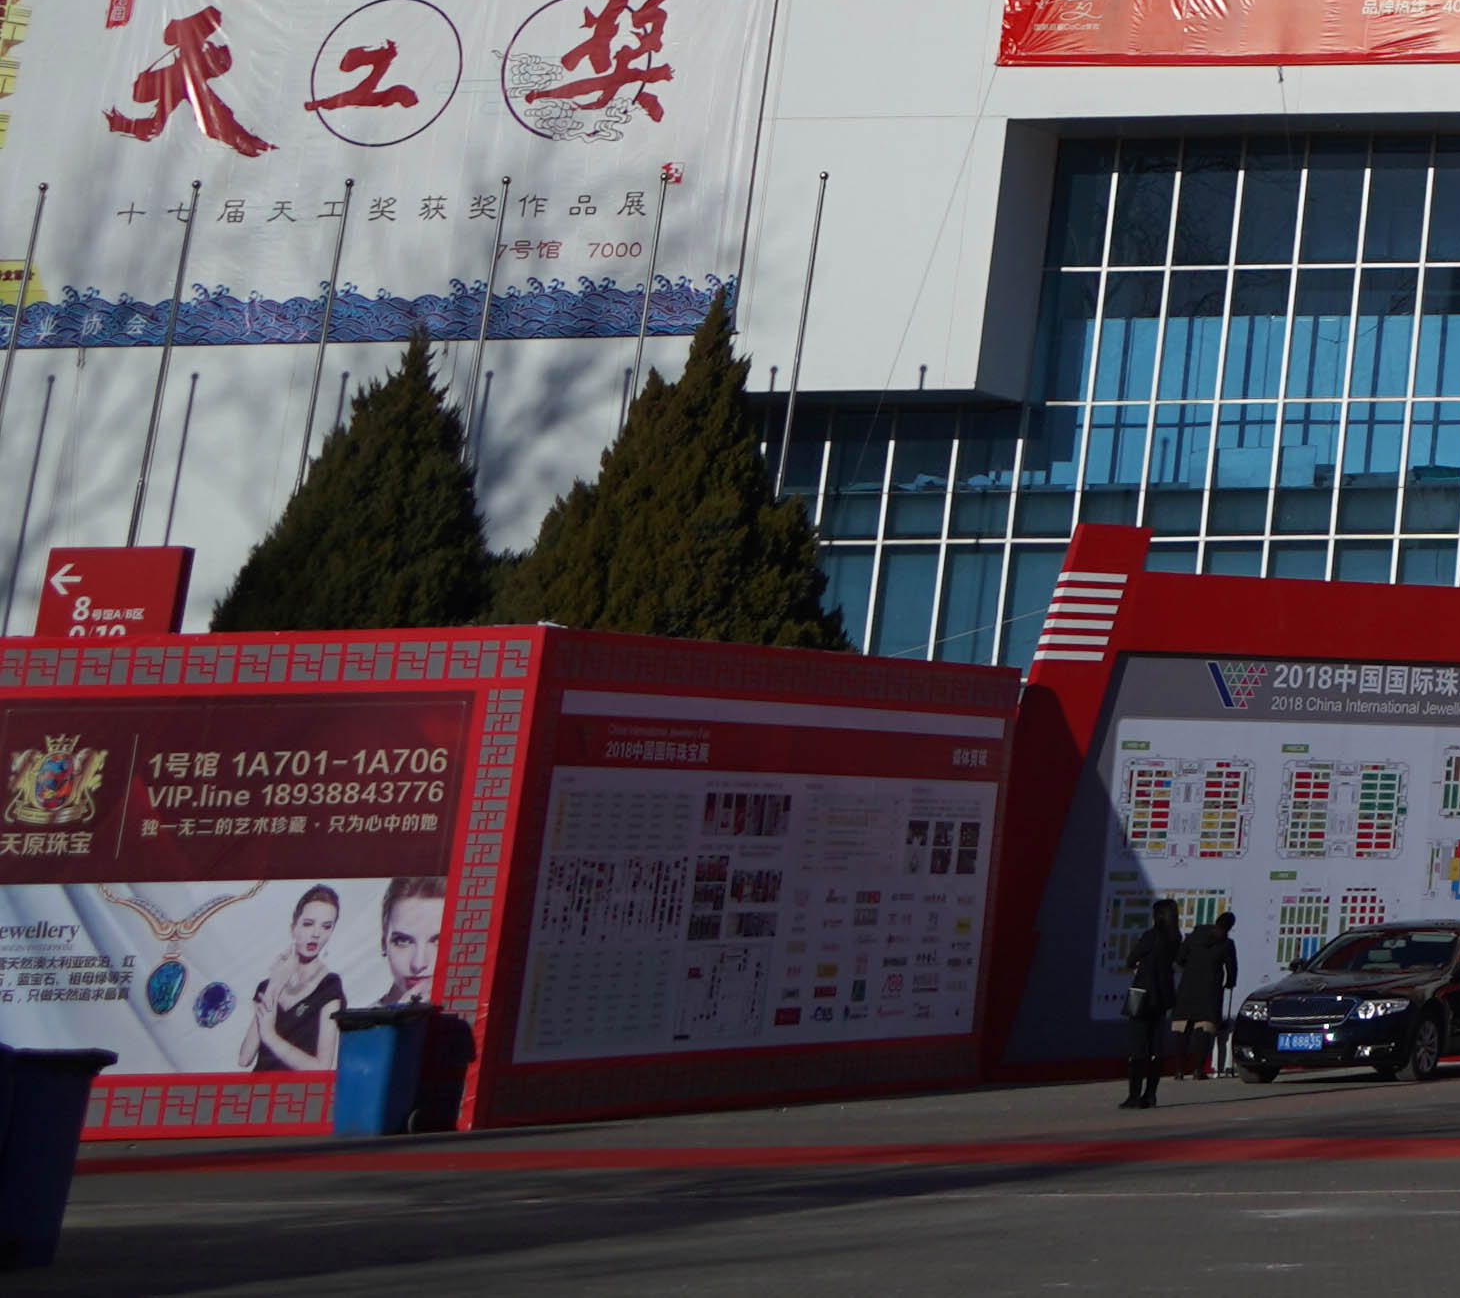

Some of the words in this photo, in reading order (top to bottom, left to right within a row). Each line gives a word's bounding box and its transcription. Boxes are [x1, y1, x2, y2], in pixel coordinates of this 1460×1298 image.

[588, 240, 643, 260] 7000
[1271, 695, 1303, 712] 2018
[1306, 696, 1343, 713] China
[1346, 698, 1420, 716] International
[148, 752, 219, 779] 1号馆
[232, 748, 449, 778] 1A701-1A706
[148, 786, 250, 808] VIP.line
[260, 780, 445, 805] 18938843776
[0, 830, 93, 856] 天原珠宝
